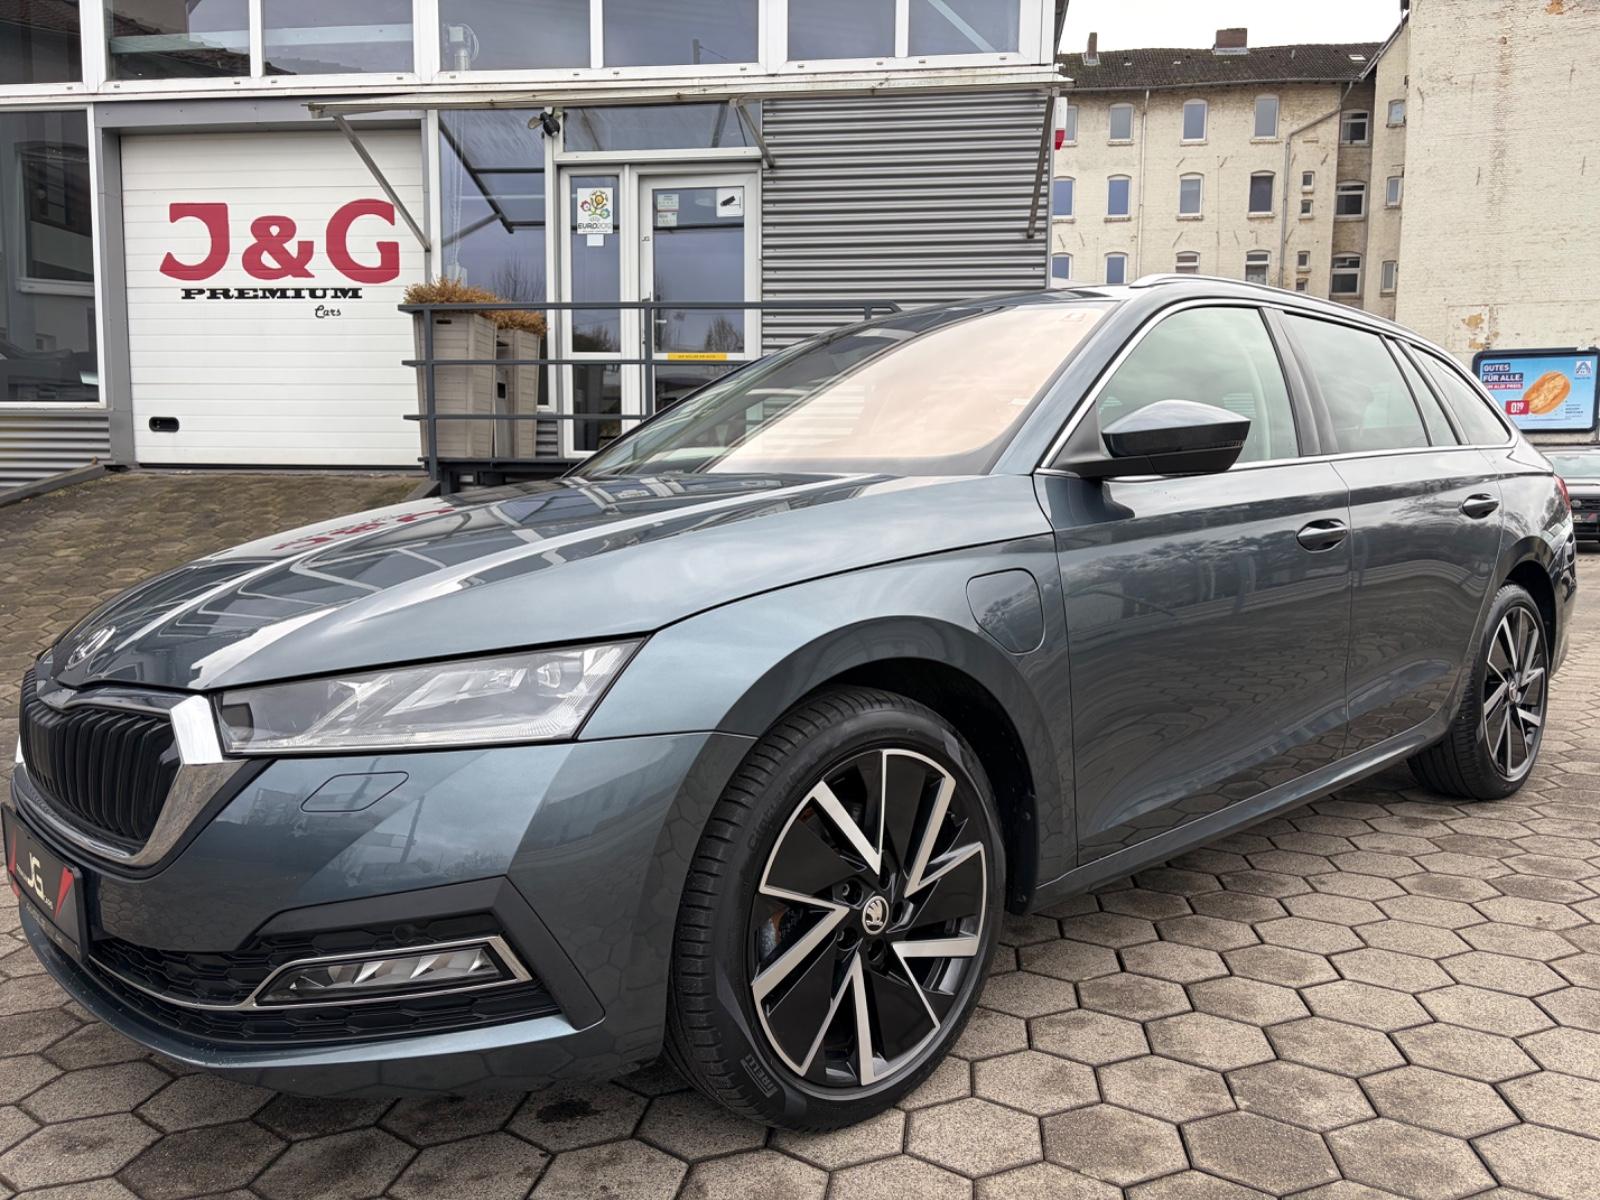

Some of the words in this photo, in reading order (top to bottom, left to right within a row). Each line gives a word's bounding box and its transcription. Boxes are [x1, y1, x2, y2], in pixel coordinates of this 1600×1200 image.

[181, 287, 363, 300] PREMIUM
[314, 304, 342, 319] Cars
[1483, 364, 1509, 372] GUTES
[1483, 373, 1500, 382] FÜR
[1500, 374, 1522, 382] ALLE.
